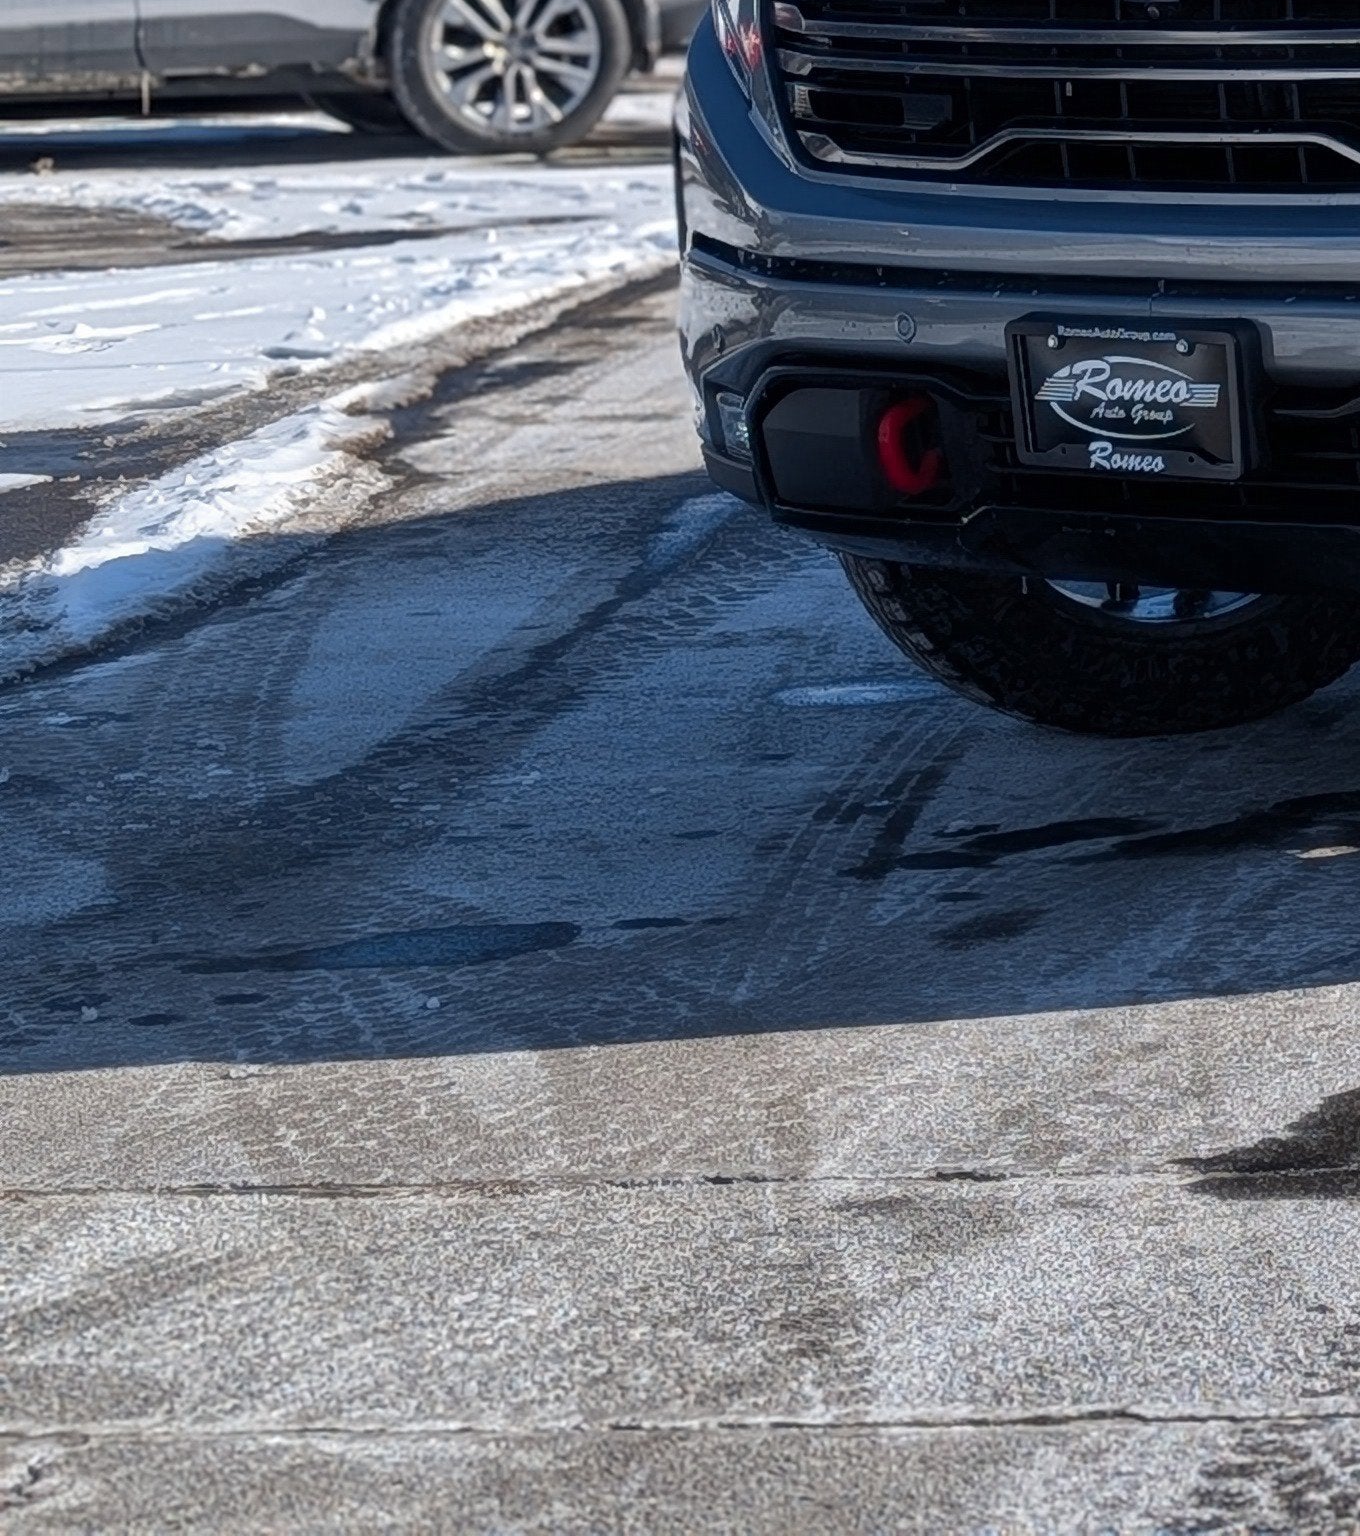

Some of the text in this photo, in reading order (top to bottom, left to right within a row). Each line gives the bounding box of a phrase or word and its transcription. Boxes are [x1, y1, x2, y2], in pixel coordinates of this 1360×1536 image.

[1072, 359, 1191, 404] Romeo
[1090, 402, 1174, 424] Auto Group
[1088, 441, 1166, 473] Romeo
